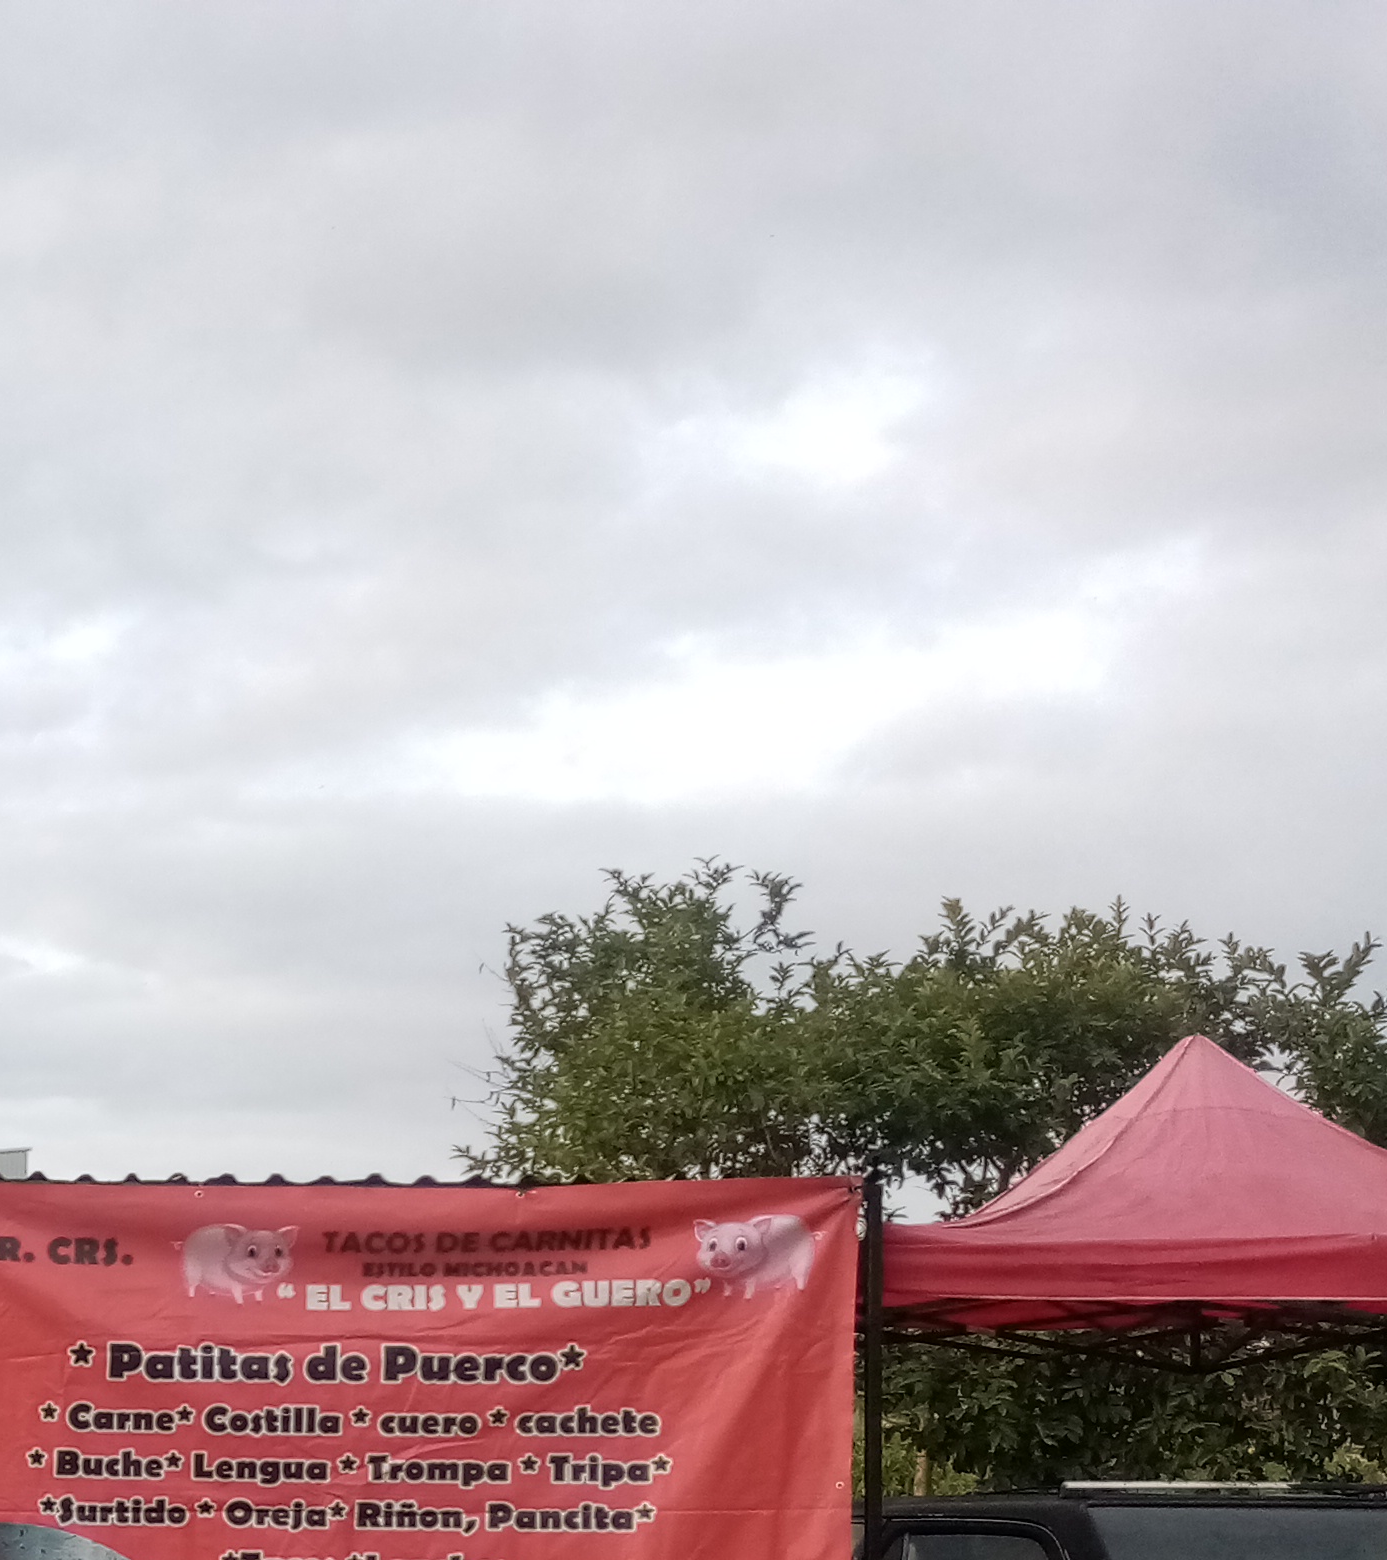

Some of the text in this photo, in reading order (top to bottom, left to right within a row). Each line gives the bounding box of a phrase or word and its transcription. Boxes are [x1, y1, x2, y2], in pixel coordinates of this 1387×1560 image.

[47, 1235, 134, 1266] CRS.
[325, 1226, 652, 1254] TACOS DE CARNITAS
[362, 1260, 589, 1278] ESTILO MICHOACAN
[305, 1284, 352, 1311] EL
[361, 1283, 447, 1312] CRIS
[455, 1285, 484, 1310] Y
[493, 1283, 542, 1309] EL
[107, 1341, 294, 1387] Patitas
[304, 1343, 368, 1384] de
[203, 1403, 343, 1438] Costilla
[379, 1412, 482, 1437] cuero
[515, 1404, 661, 1438] cachete
[191, 1451, 332, 1485] Lengua
[365, 1453, 512, 1489] Trompa
[354, 1499, 480, 1536] Riñon,
